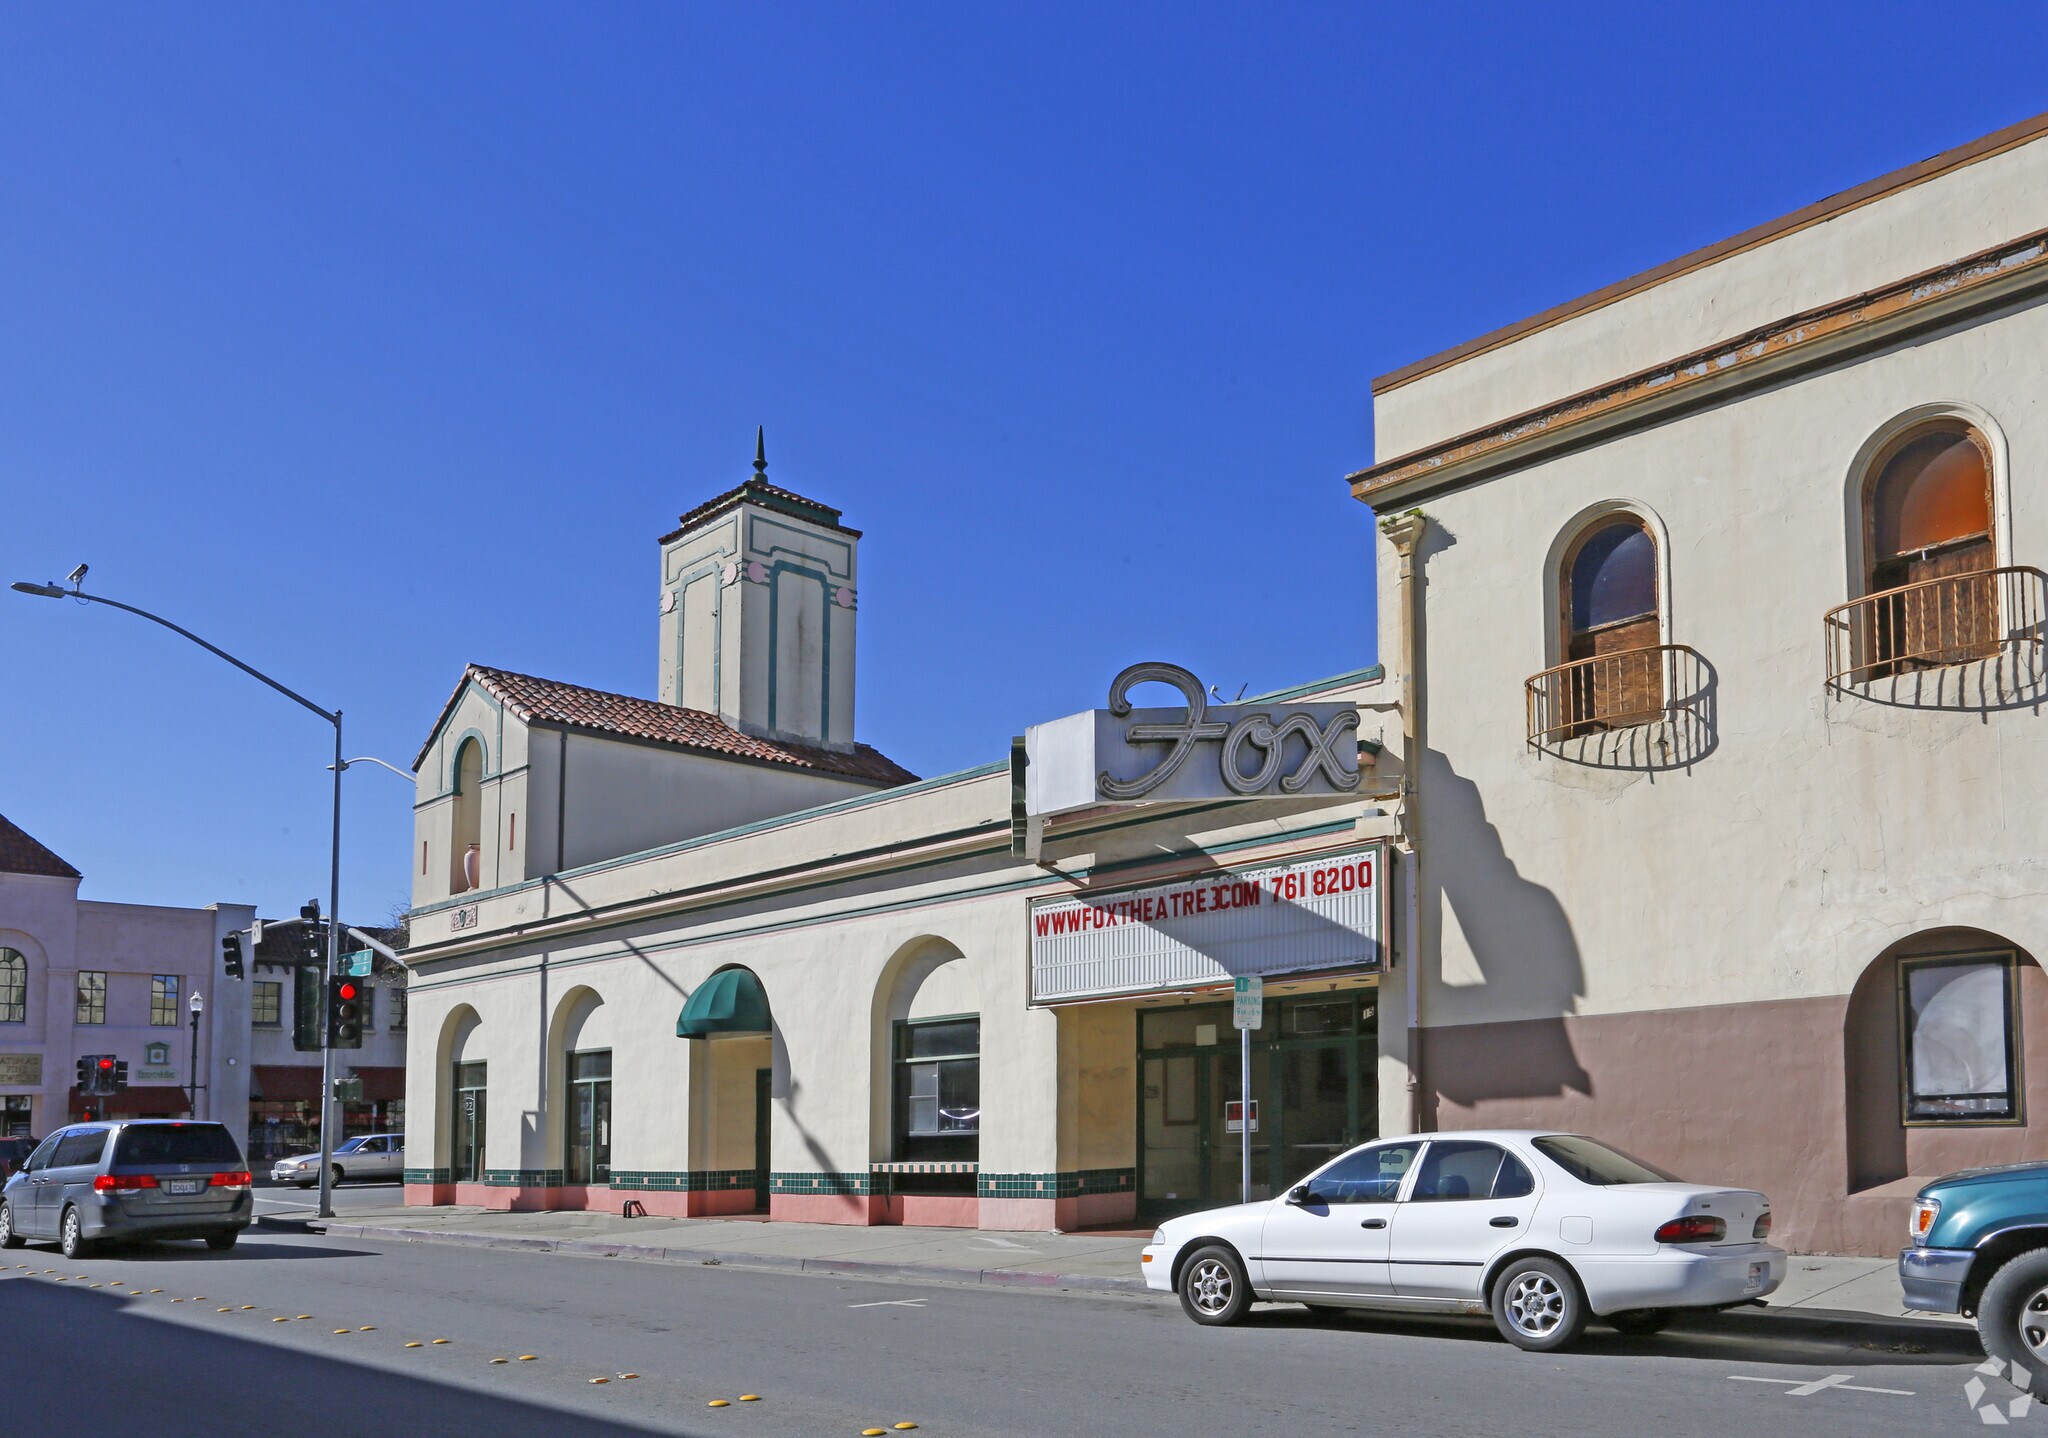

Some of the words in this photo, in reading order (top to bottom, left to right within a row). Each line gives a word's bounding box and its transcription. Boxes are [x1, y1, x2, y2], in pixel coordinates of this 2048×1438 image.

[1096, 662, 1360, 800] Fox
[1271, 872, 1306, 904] 761
[1313, 861, 1373, 897] 8200
[1236, 995, 1261, 1006] PARKING
